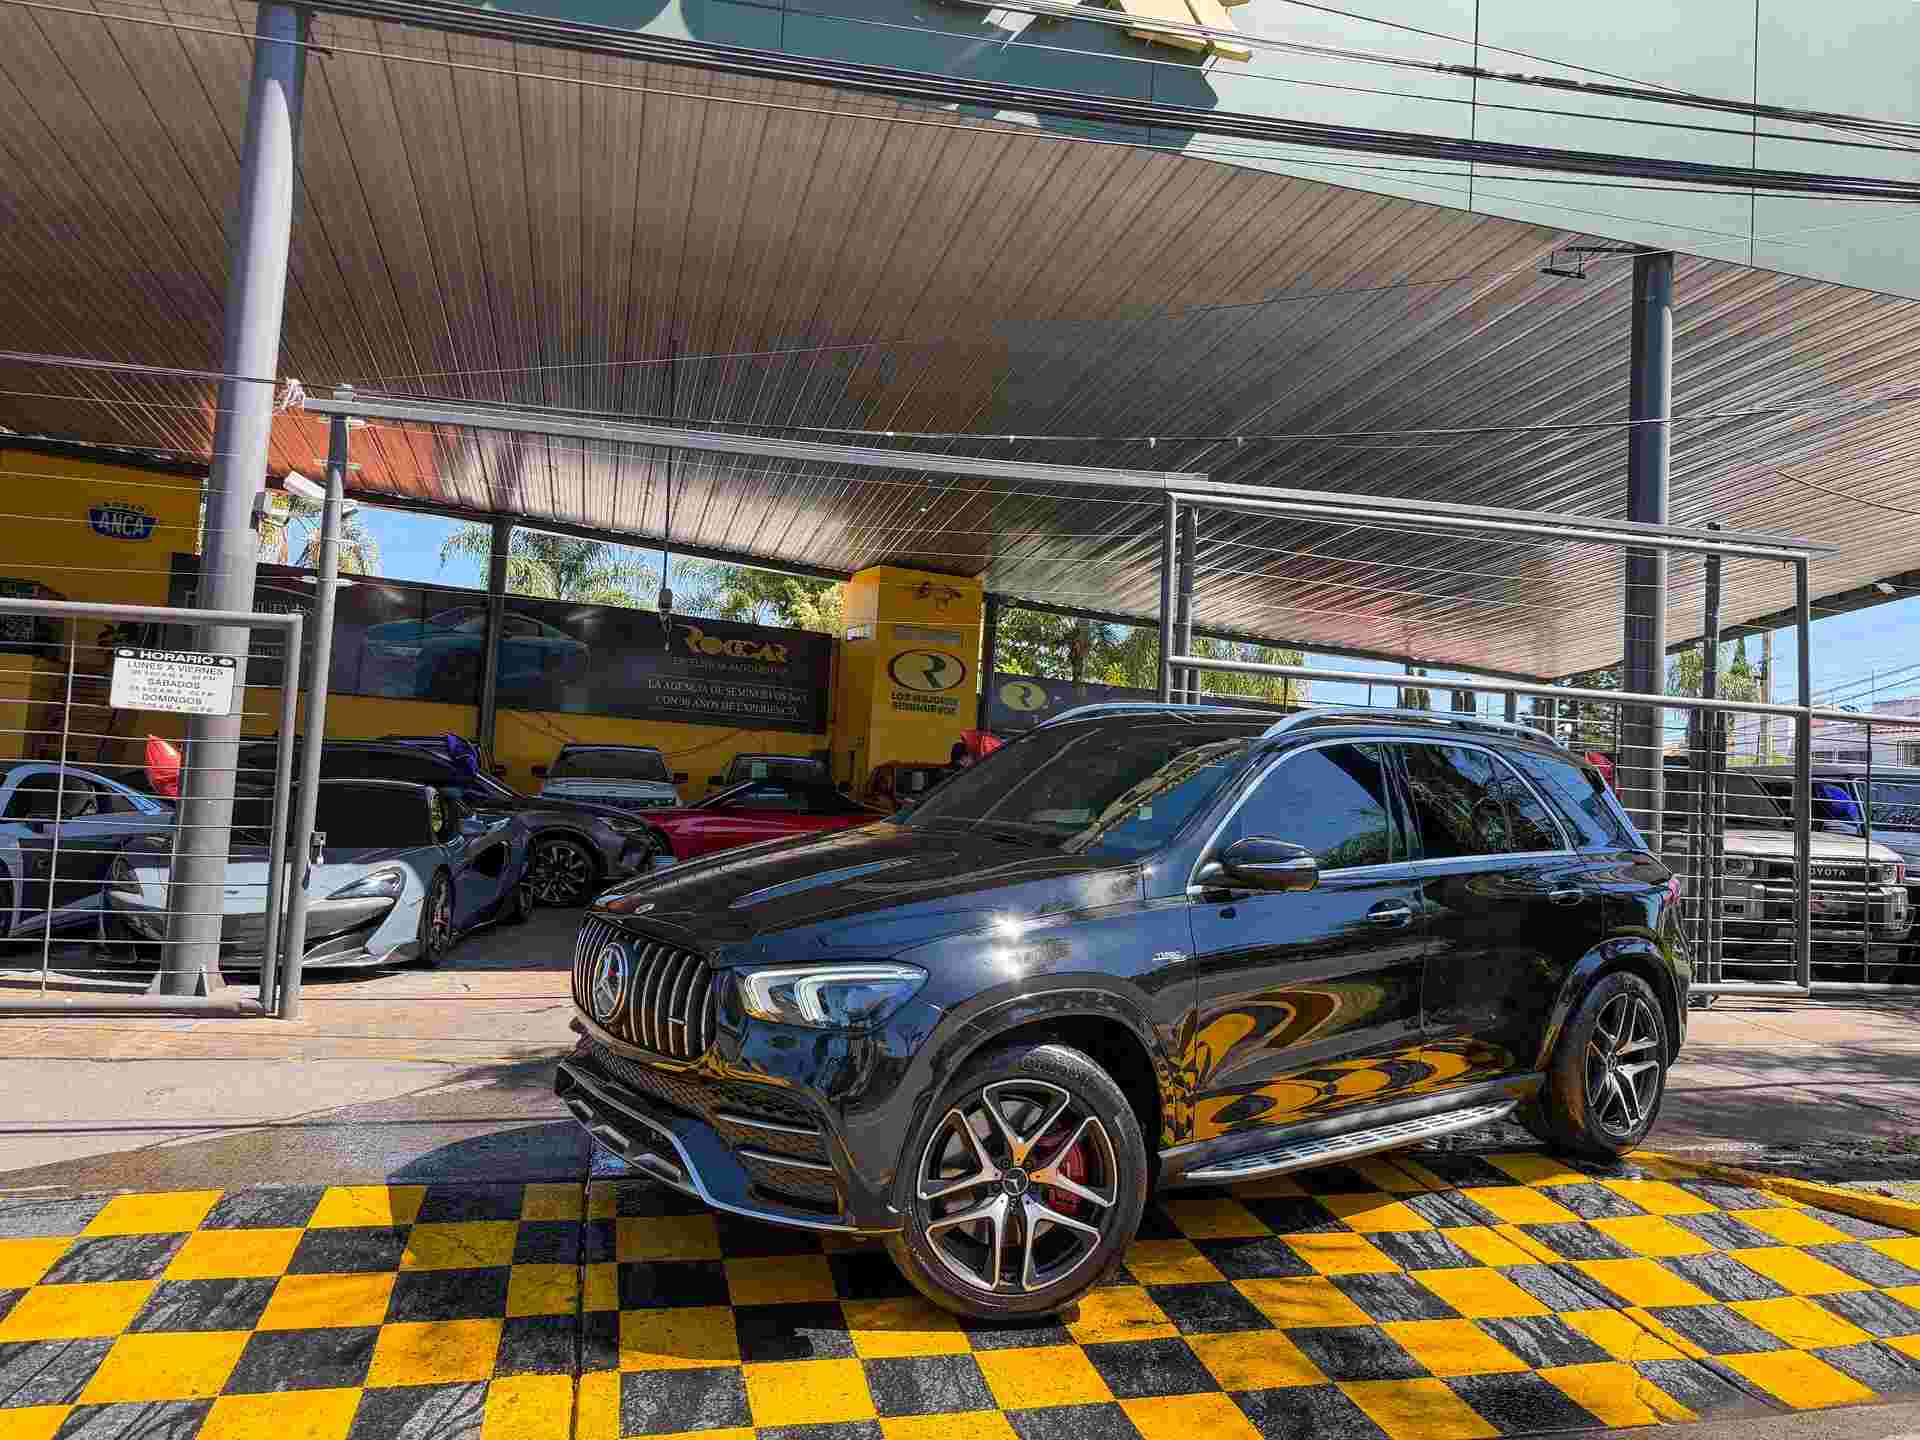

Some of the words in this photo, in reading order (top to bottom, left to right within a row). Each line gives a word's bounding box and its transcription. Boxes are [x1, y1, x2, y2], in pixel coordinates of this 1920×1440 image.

[139, 650, 215, 665] HORARIO
[127, 660, 163, 671] LUNES
[178, 664, 224, 676] VIERNES
[141, 693, 202, 705] DOMINGOS
[1808, 866, 1847, 878] OYOTA
